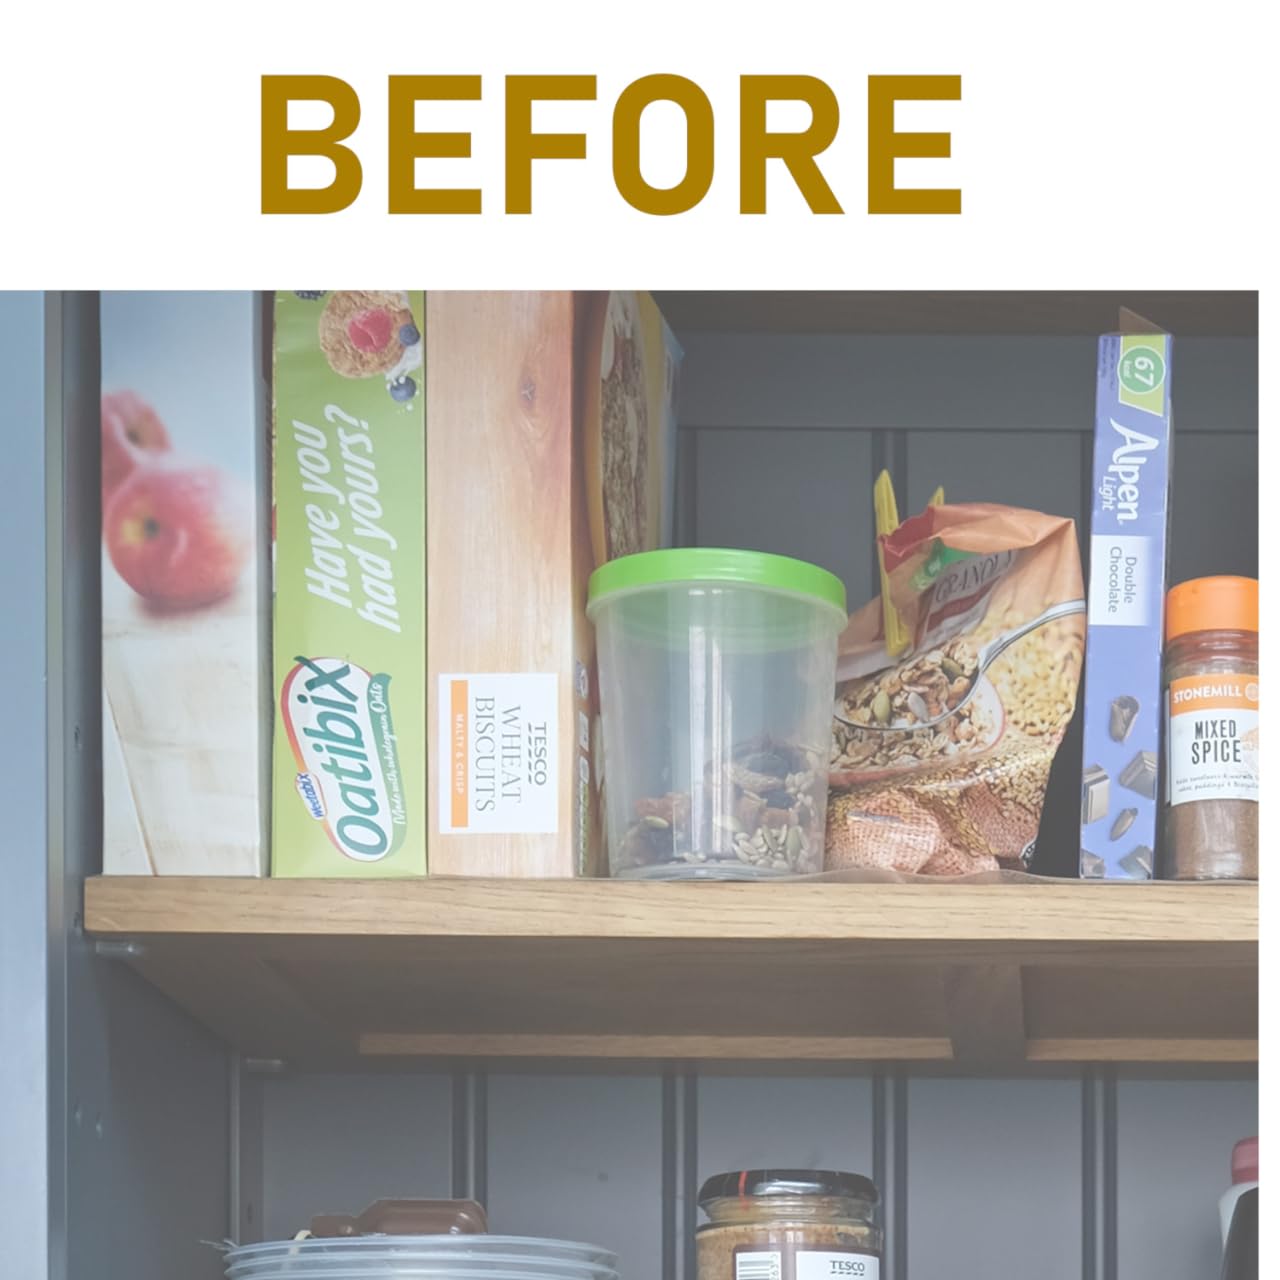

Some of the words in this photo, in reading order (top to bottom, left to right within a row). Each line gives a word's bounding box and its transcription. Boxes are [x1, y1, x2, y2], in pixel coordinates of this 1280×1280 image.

[1134, 356, 1155, 387] 67
[291, 419, 346, 505] you
[323, 403, 398, 551] yours?
[1098, 475, 1118, 512] Light
[1108, 417, 1161, 522] Alpen
[304, 503, 353, 609] Have
[345, 543, 401, 633] had
[1108, 545, 1123, 613] Chocolate
[1123, 556, 1138, 604] Double
[1173, 684, 1244, 704] STONEMILL
[293, 655, 389, 856] Oatibix
[475, 696, 496, 812] BISCUITS
[501, 705, 522, 804] WHEAT
[533, 721, 548, 786] TESCO
[1191, 739, 1243, 765] SPICE
[1194, 719, 1237, 740] MIXED
[830, 1260, 866, 1272] TESCO
